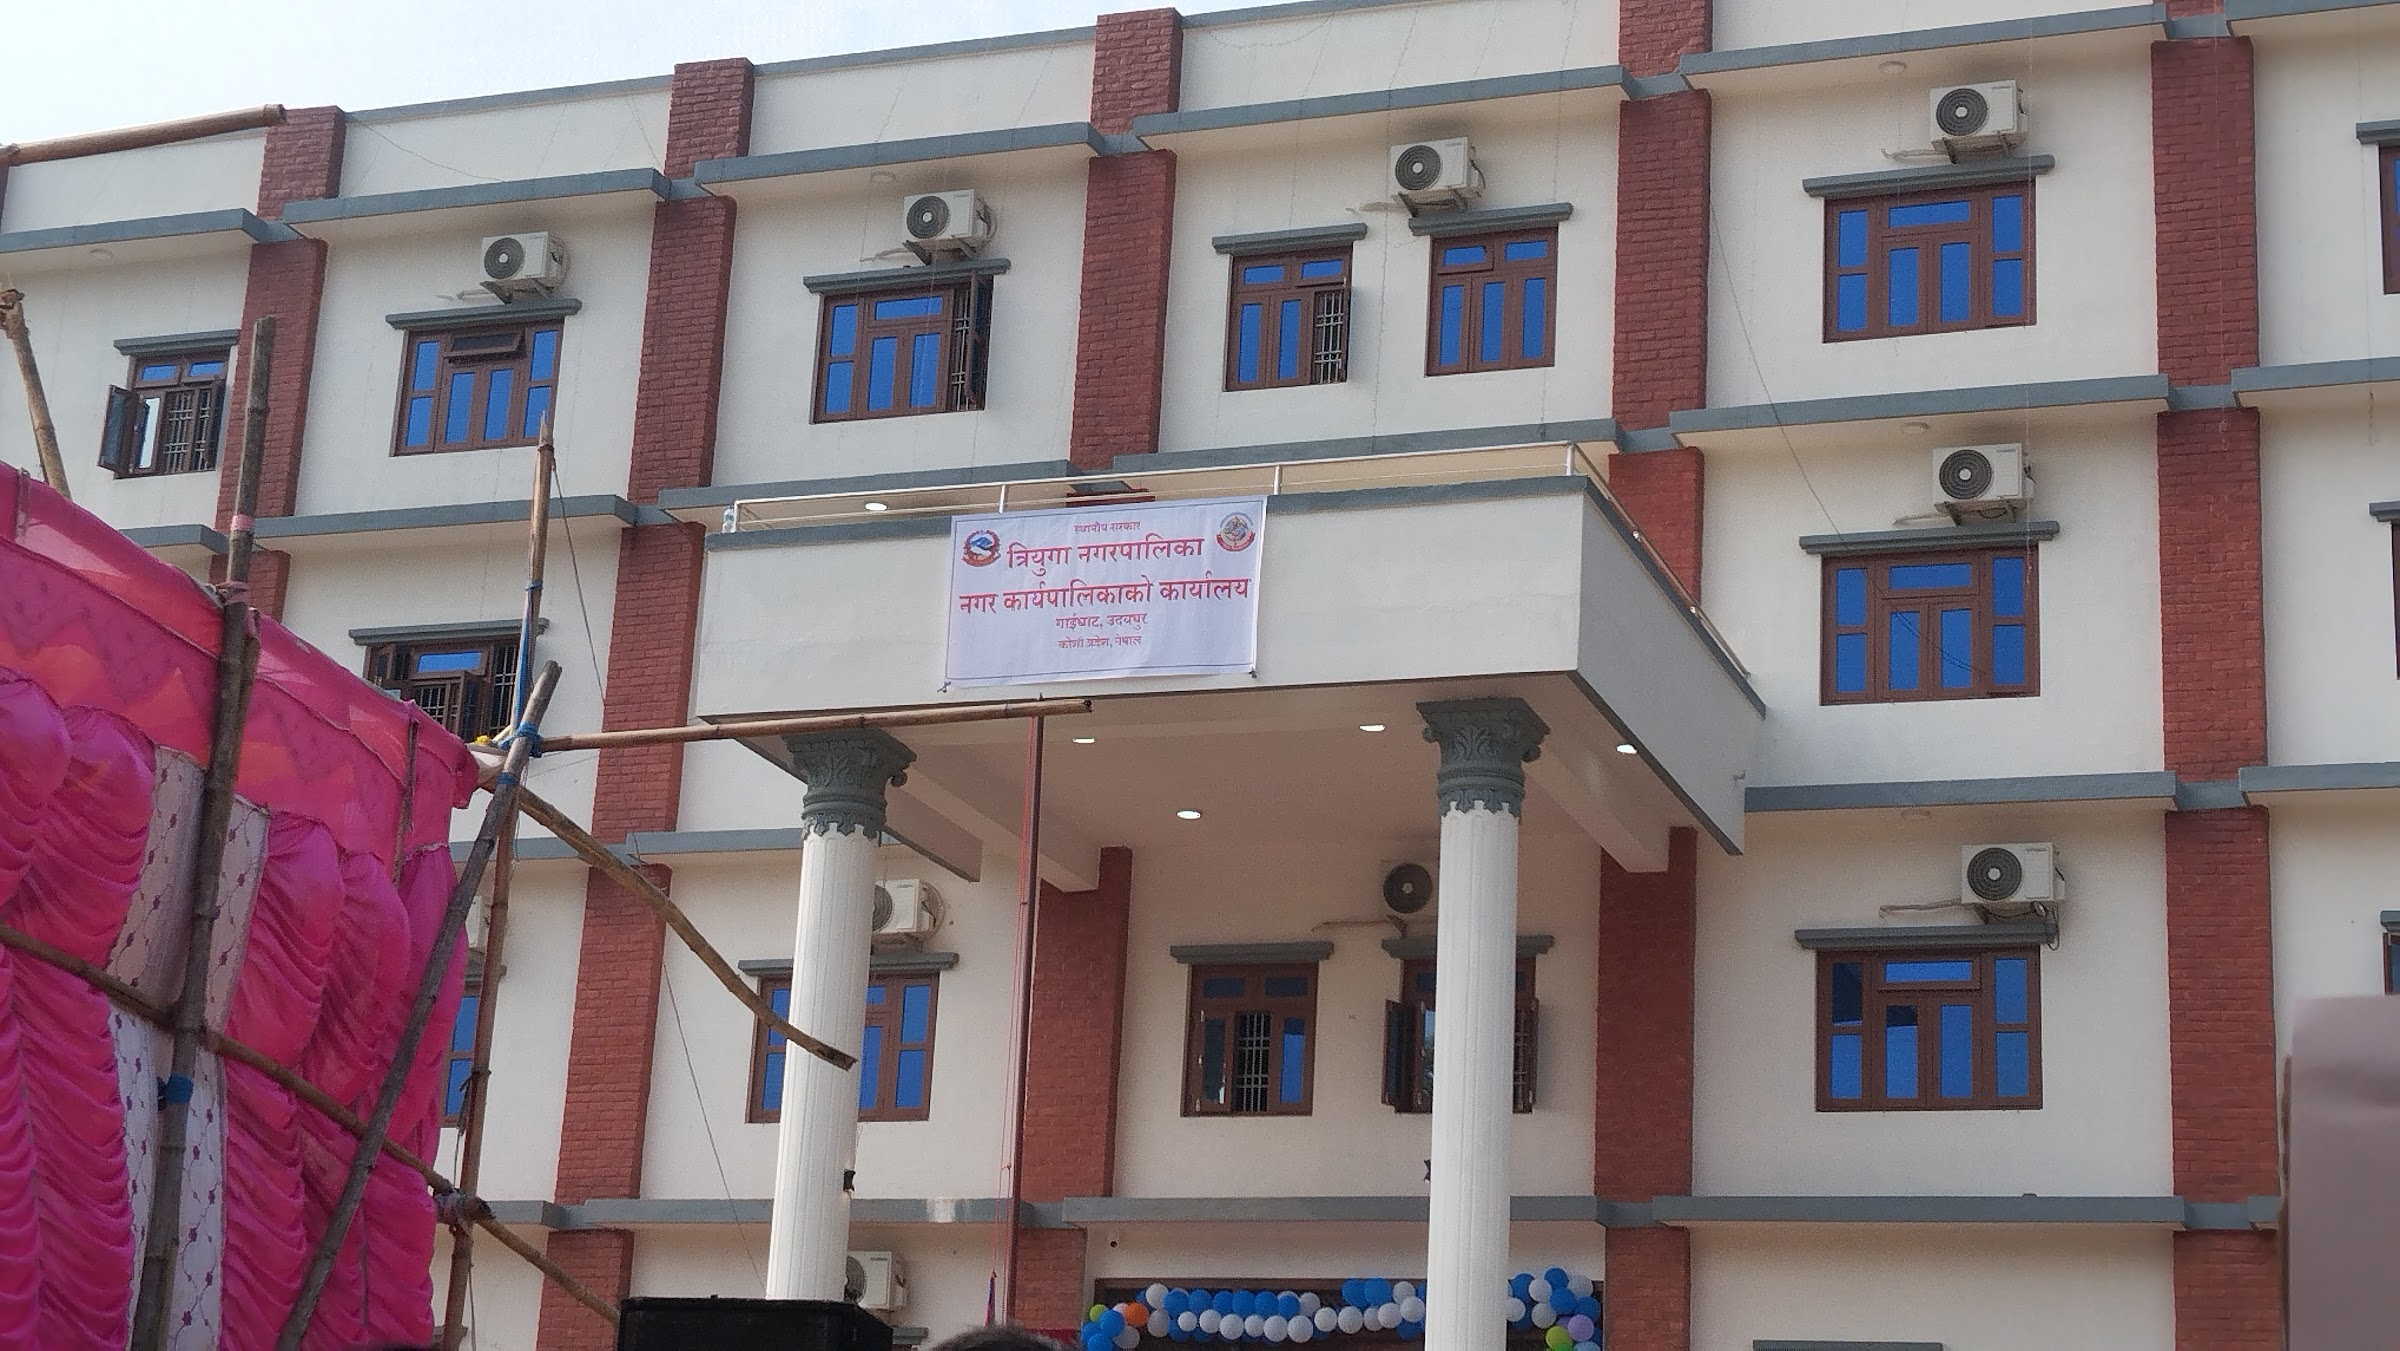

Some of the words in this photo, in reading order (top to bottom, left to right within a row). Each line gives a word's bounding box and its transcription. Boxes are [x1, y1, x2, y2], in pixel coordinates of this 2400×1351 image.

[1006, 542, 1072, 577] त्रियुगा
[1077, 532, 1205, 562] नगरपालिका
[959, 593, 998, 613] नगर
[1003, 574, 1154, 610] कार्यपालिकाको
[1159, 570, 1252, 600] कार्यालय
